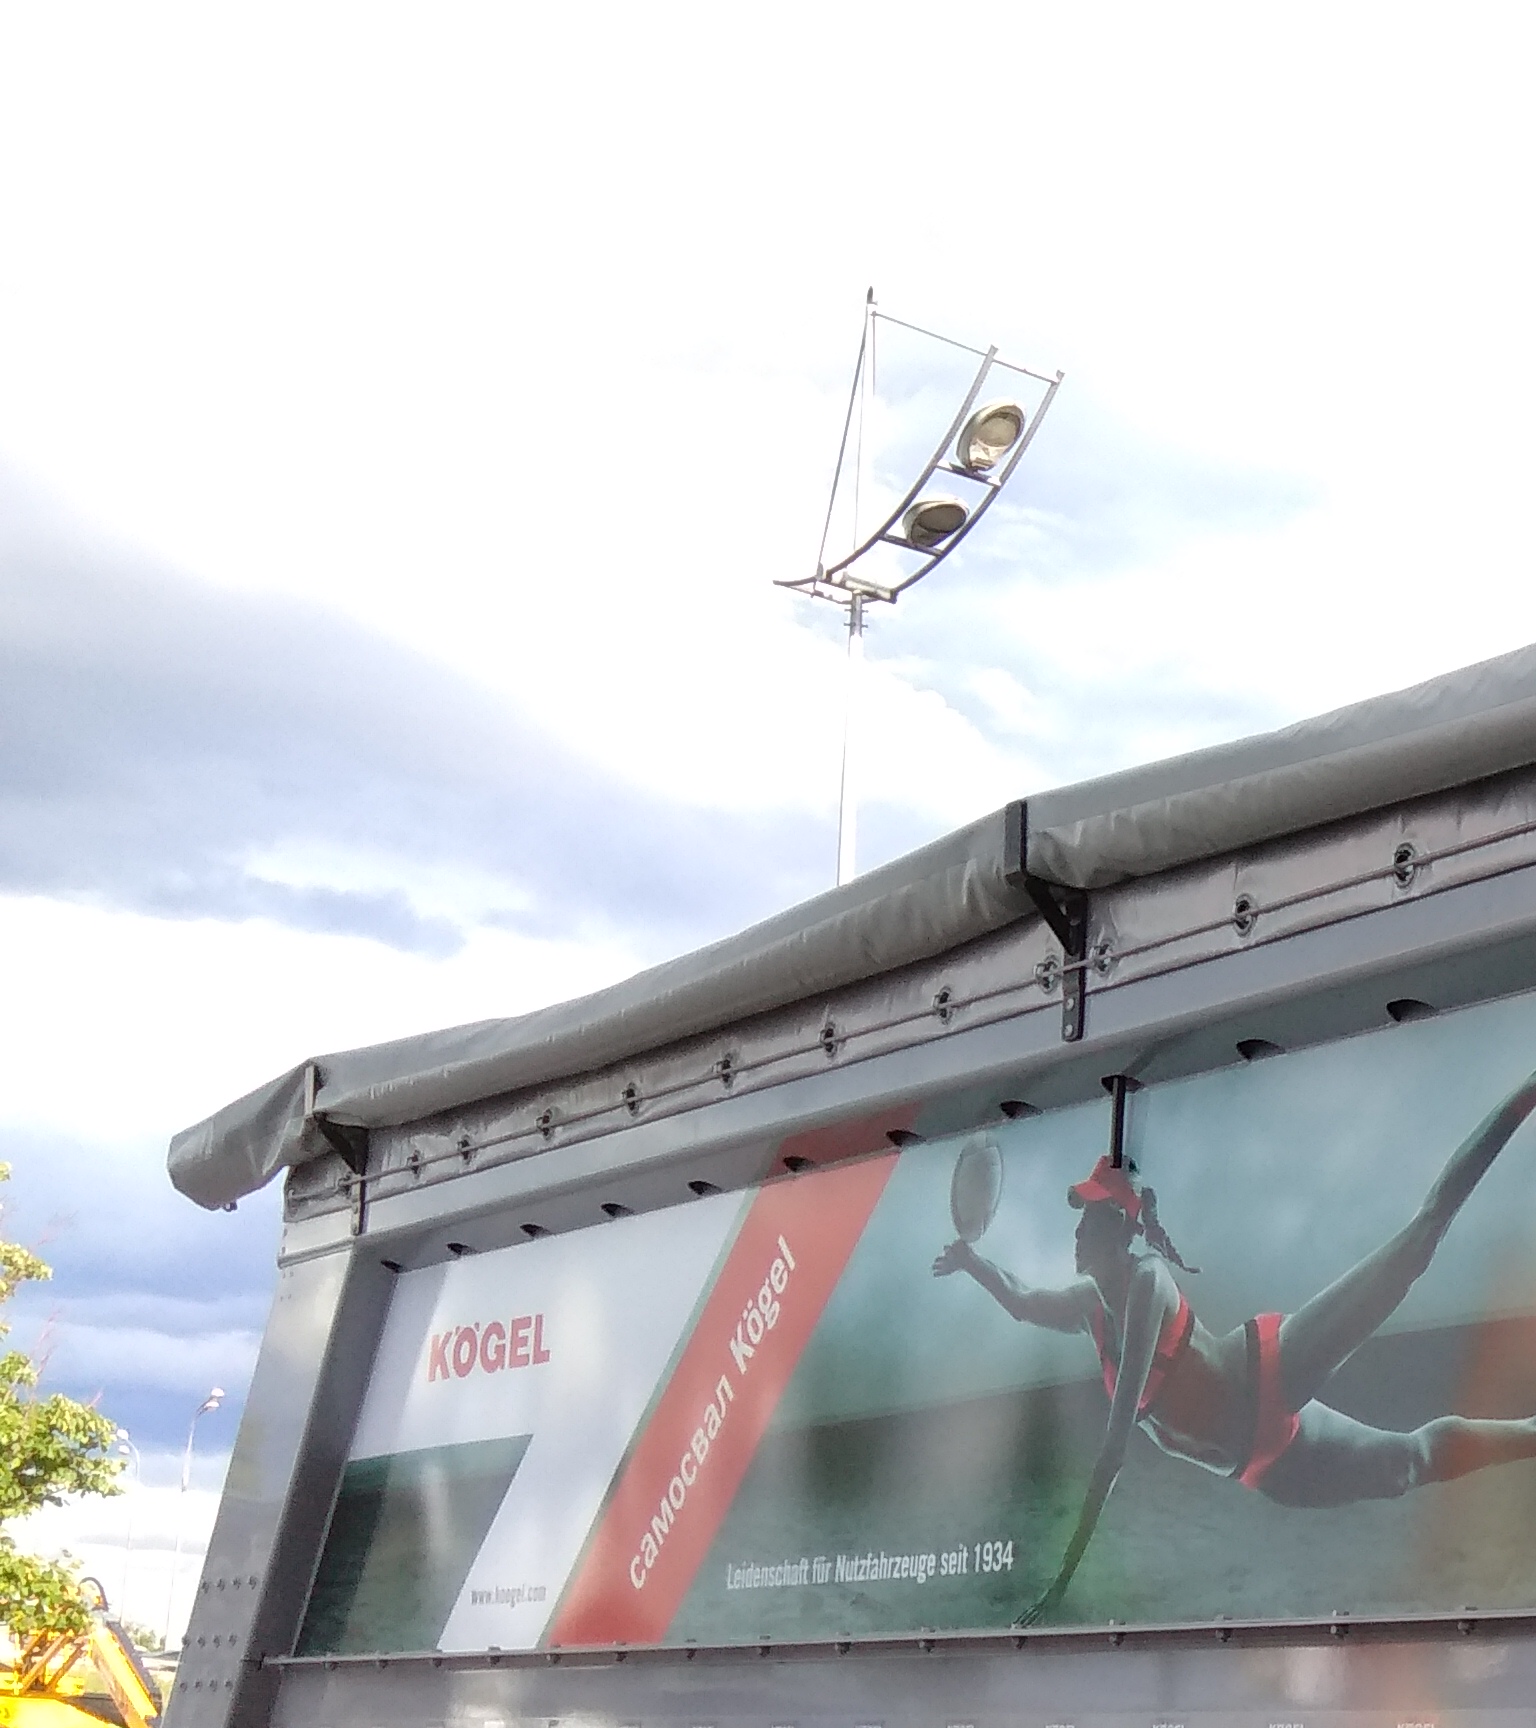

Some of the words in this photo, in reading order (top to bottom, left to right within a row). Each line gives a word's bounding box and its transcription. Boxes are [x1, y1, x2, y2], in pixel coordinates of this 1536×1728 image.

[729, 1234, 796, 1375] Kögel
[427, 1313, 550, 1383] KÖGEL
[727, 1559, 810, 1591] Leidenschaft
[812, 1558, 832, 1585] für
[835, 1549, 936, 1587] Nutzfahrzeuge
[939, 1548, 969, 1577] seit
[973, 1542, 1015, 1573] 1934
